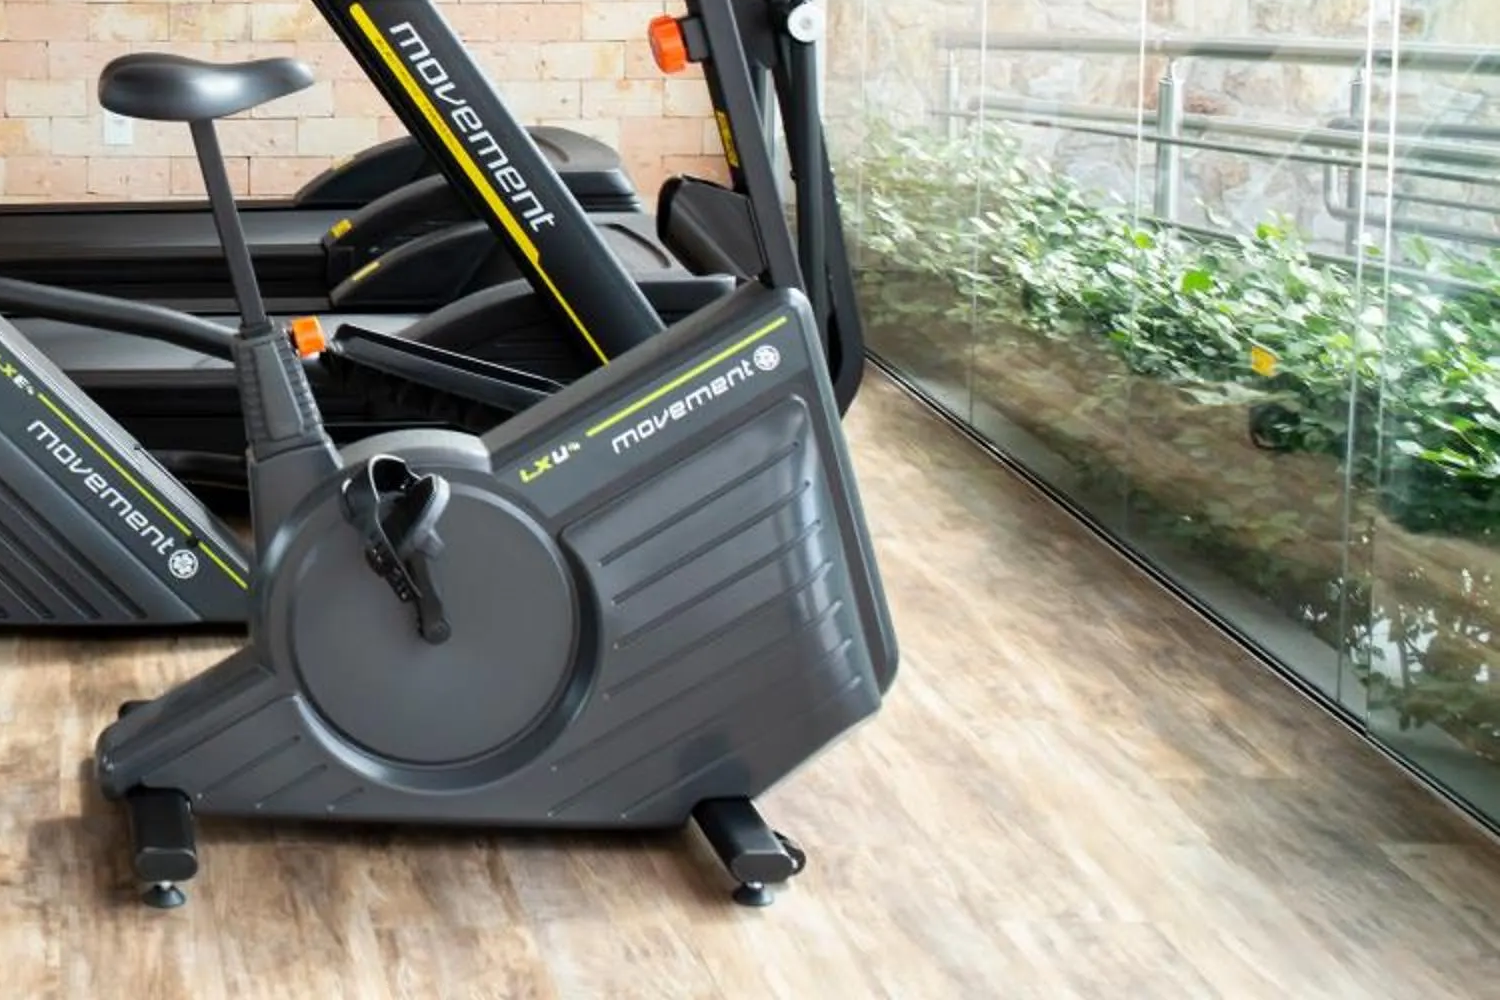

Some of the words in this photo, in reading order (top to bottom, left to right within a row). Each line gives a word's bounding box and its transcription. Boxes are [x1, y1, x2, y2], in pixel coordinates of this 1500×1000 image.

[389, 21, 556, 233] movement
[611, 359, 755, 454] movement
[27, 419, 176, 555] movement
